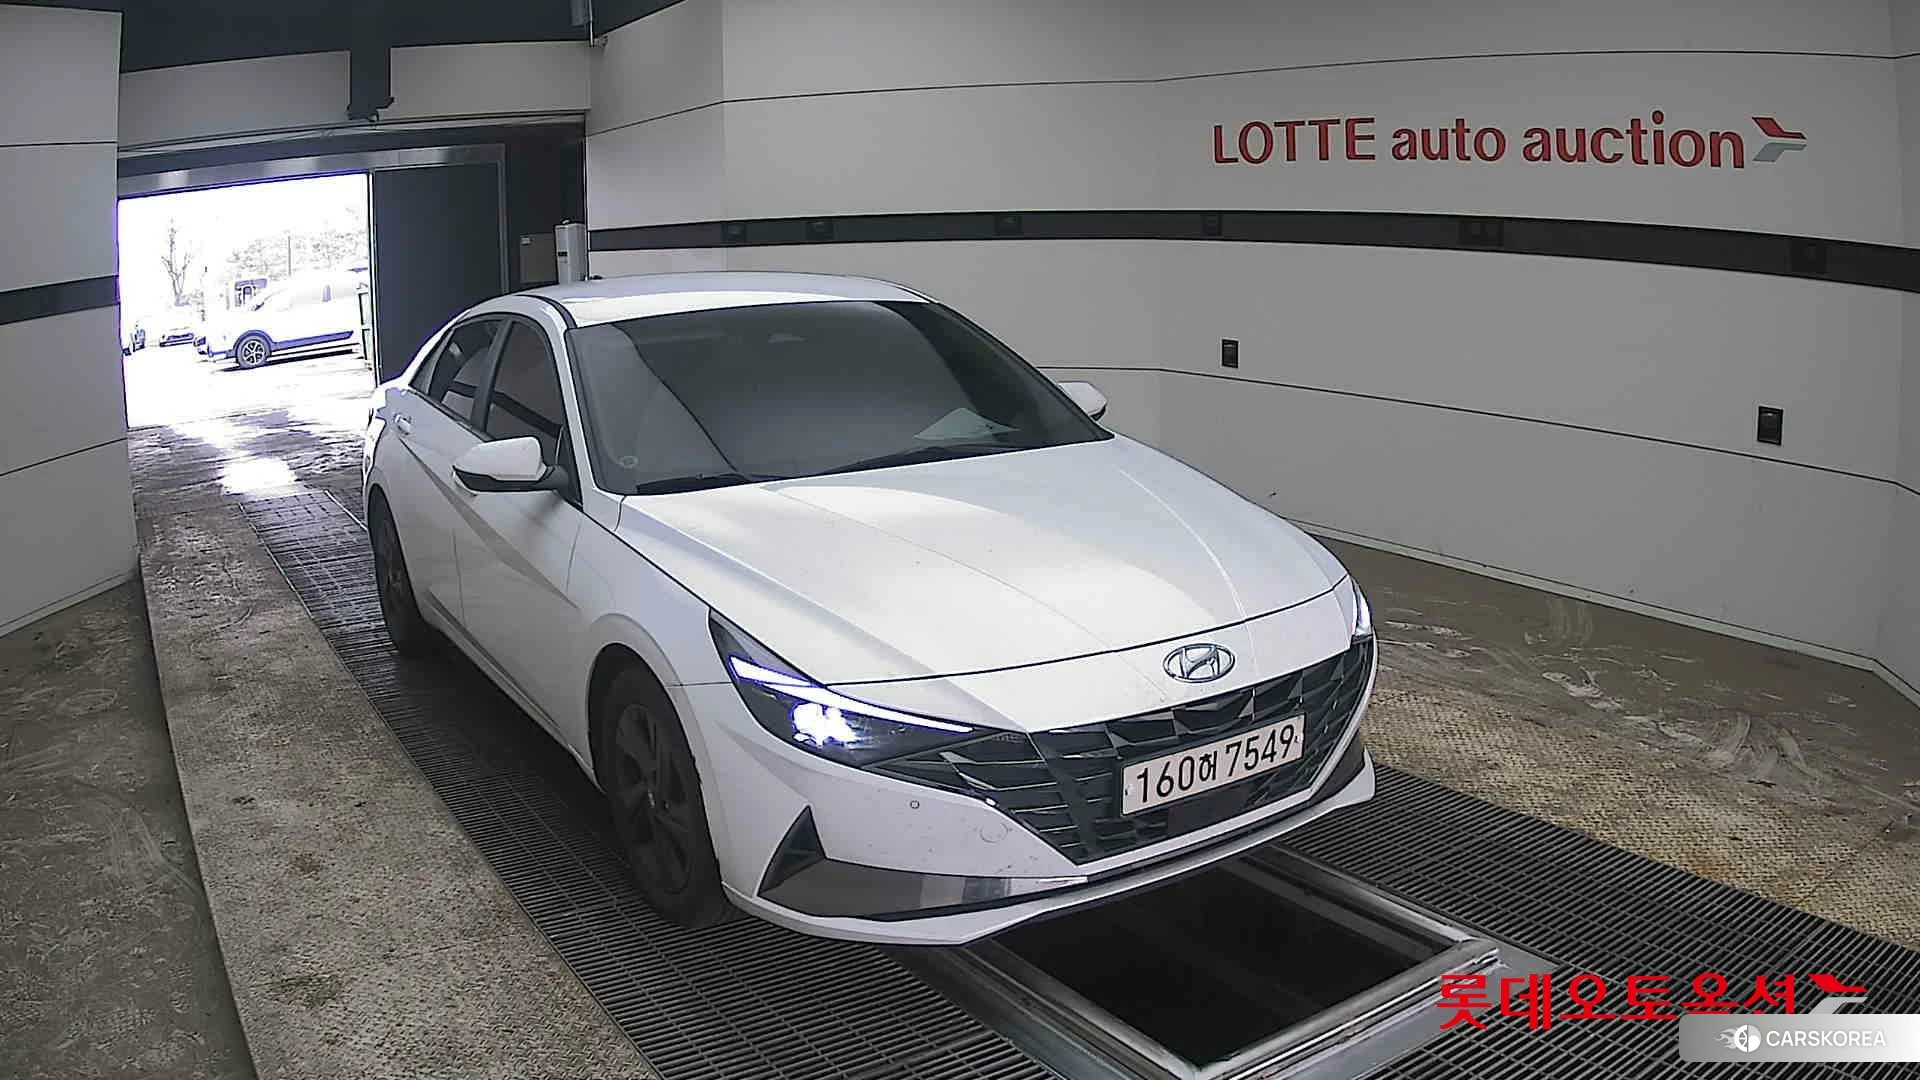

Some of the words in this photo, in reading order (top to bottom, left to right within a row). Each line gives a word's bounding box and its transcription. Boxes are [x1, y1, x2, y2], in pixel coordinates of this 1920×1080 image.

[1213, 117, 1376, 164] LOTTE
[1392, 118, 1507, 162] auto
[1522, 111, 1746, 169] auction
